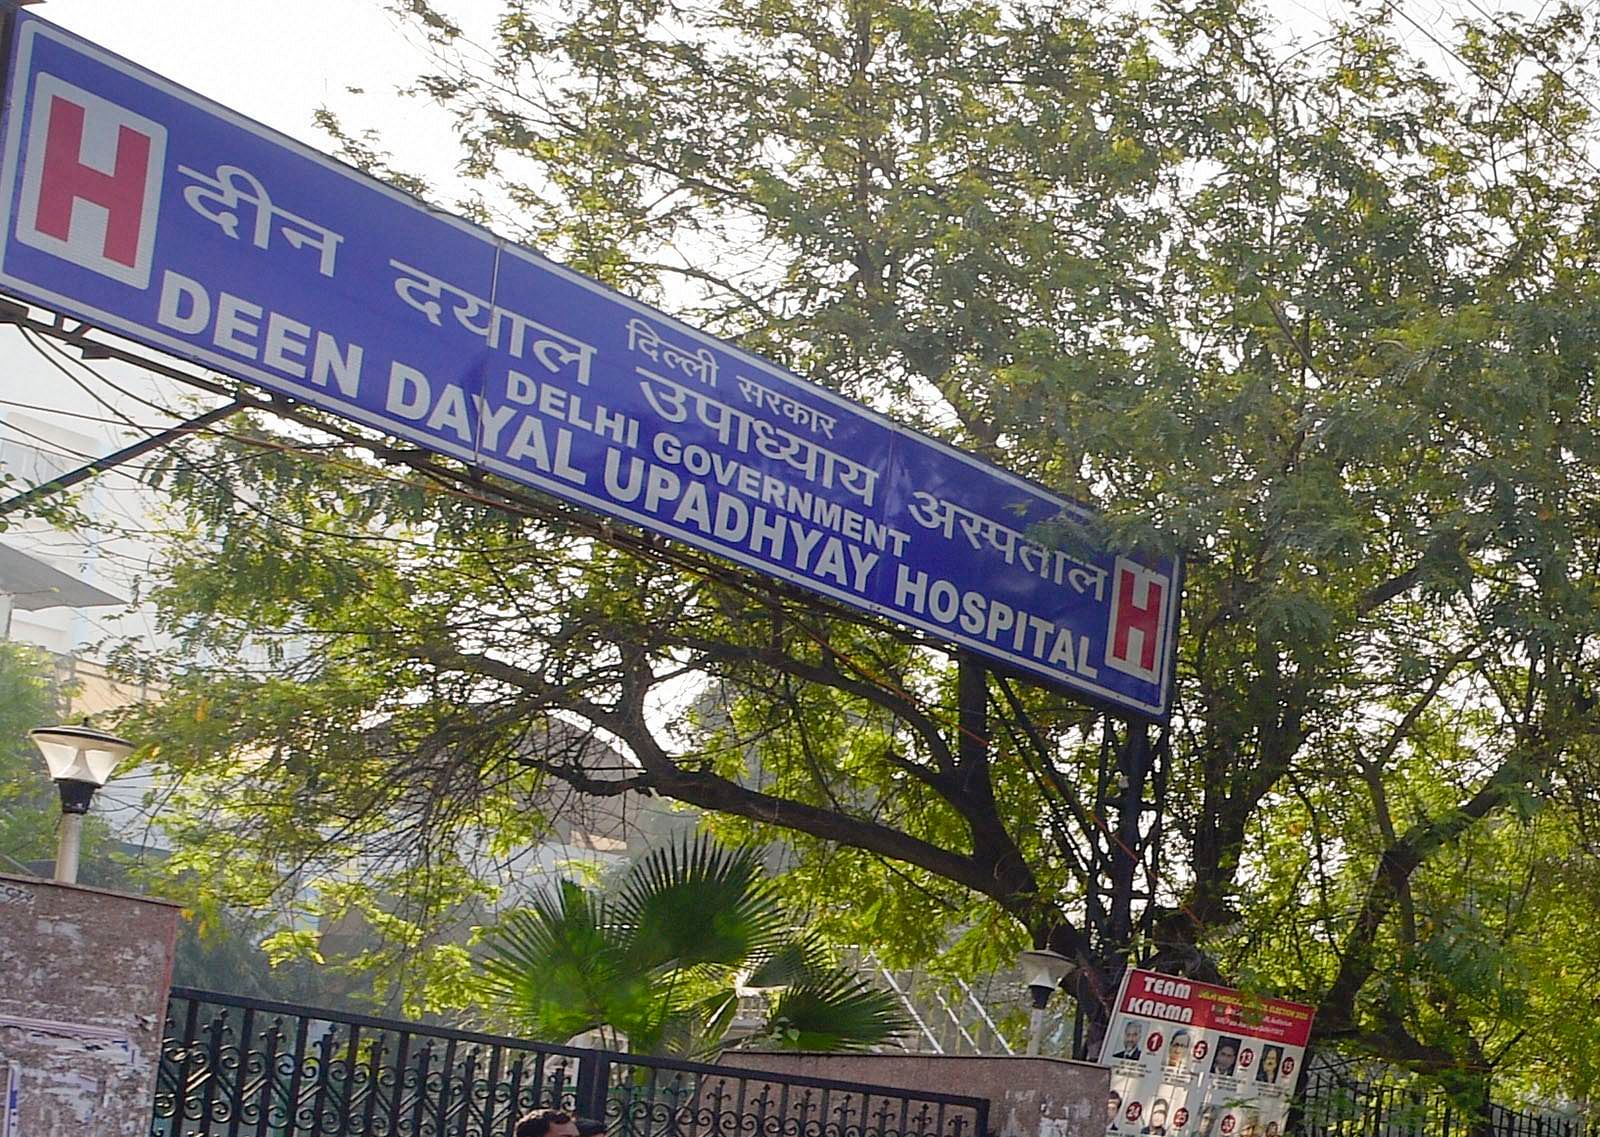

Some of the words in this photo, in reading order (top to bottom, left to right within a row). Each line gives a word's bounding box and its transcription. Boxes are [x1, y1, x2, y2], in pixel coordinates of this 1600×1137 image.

[35, 94, 152, 268] H
[178, 164, 344, 278] दीन
[390, 258, 598, 386] दयाल
[635, 366, 879, 507] उपाध्याय
[908, 489, 1108, 602] अस्पताल
[626, 318, 719, 387] दिल्ली
[736, 375, 837, 440] सरकार
[157, 270, 364, 399] DEEN
[386, 362, 587, 485] DAYAL
[605, 448, 879, 593] UPADHYAY
[895, 563, 1099, 681] HOSPITAL
[506, 371, 639, 445] DELHI
[654, 432, 911, 558] GOVERNMENT
[1113, 565, 1162, 671] H
[1127, 997, 1193, 1023] KARMA
[1144, 976, 1192, 999] TEAM
[1150, 1035, 1159, 1048] 1
[1195, 1043, 1206, 1057] 5
